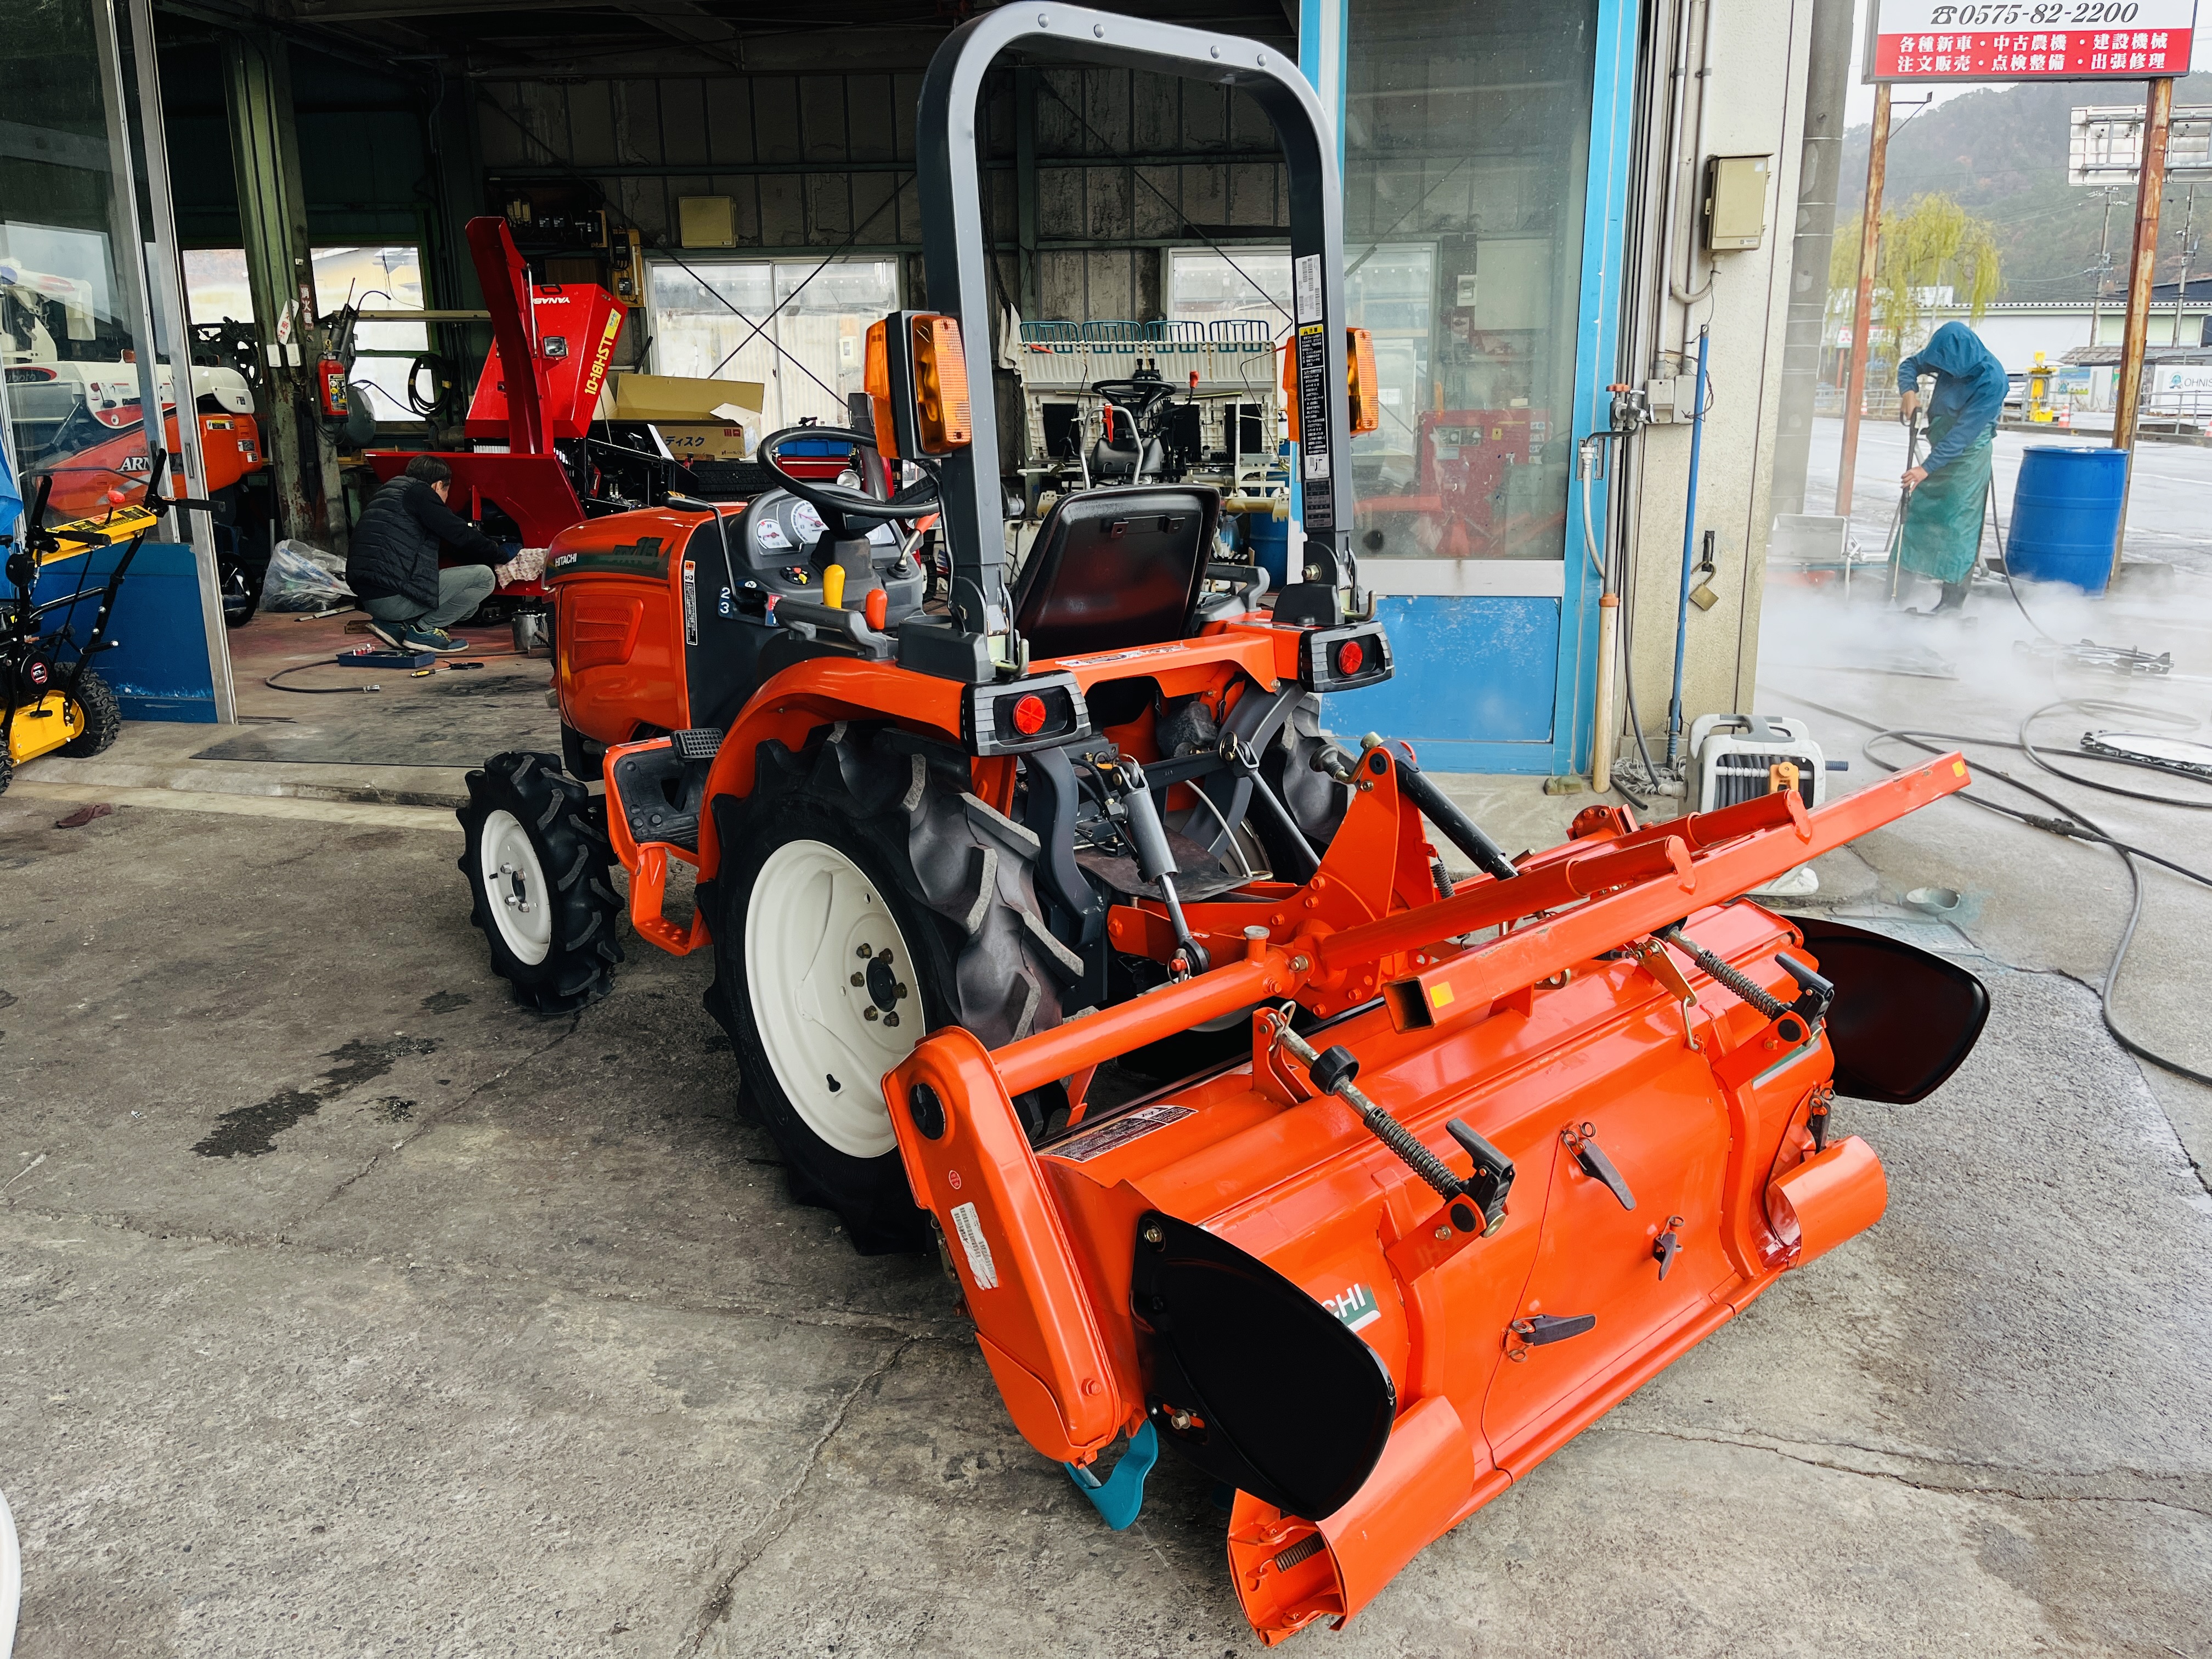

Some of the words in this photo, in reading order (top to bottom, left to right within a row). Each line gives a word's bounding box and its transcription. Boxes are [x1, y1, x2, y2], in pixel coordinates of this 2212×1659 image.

[1959, 3, 2138, 25] 0575-82-2200
[1899, 32, 2168, 53] 各種新車・中古農機・建設機械
[1897, 52, 2166, 72] 注文販売・点検整備・出張修理
[584, 336, 613, 395] 10-18HST
[555, 553, 577, 567] HITACHI
[720, 586, 731, 600] 2
[720, 601, 730, 614] 3
